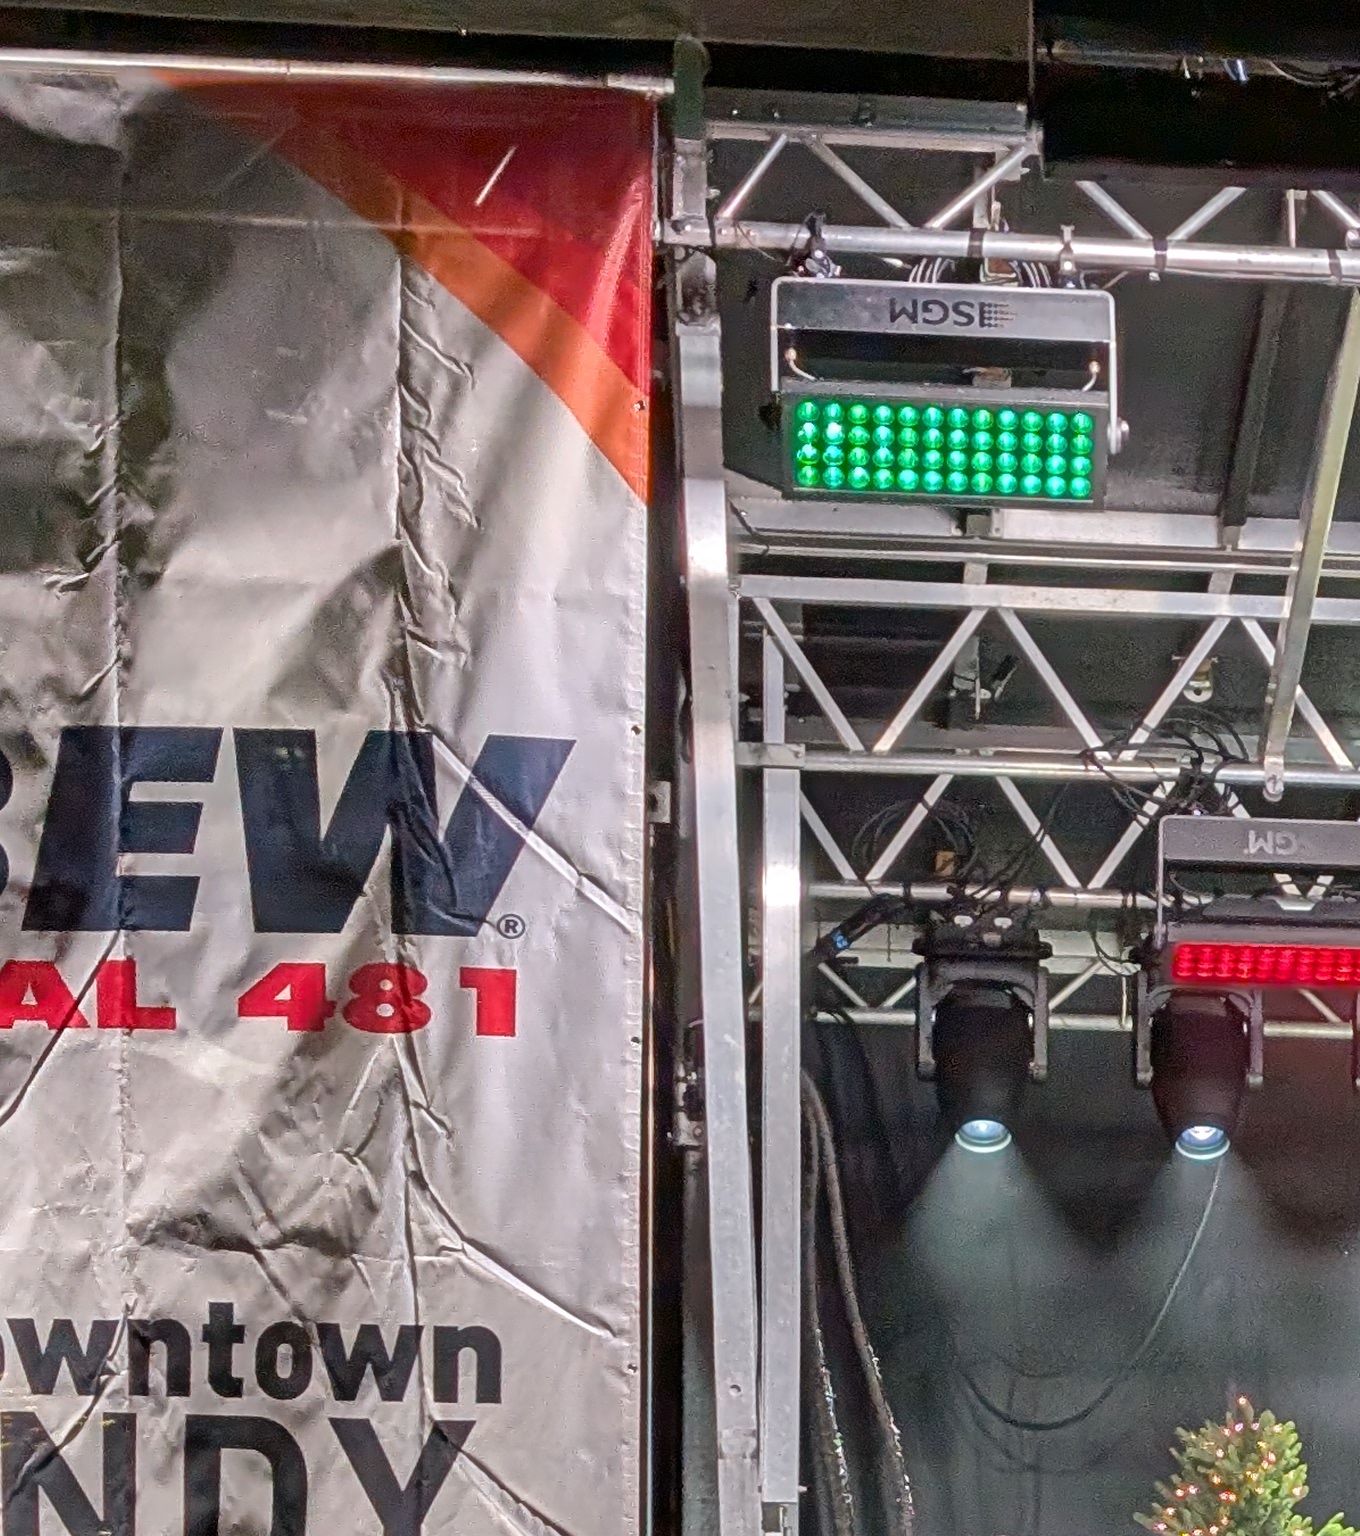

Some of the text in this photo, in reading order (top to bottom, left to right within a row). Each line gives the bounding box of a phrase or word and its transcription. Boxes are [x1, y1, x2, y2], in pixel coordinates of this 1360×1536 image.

[0, 726, 577, 937] EW
[0, 960, 517, 1037] AL 481
[0, 1302, 501, 1404] wntown
